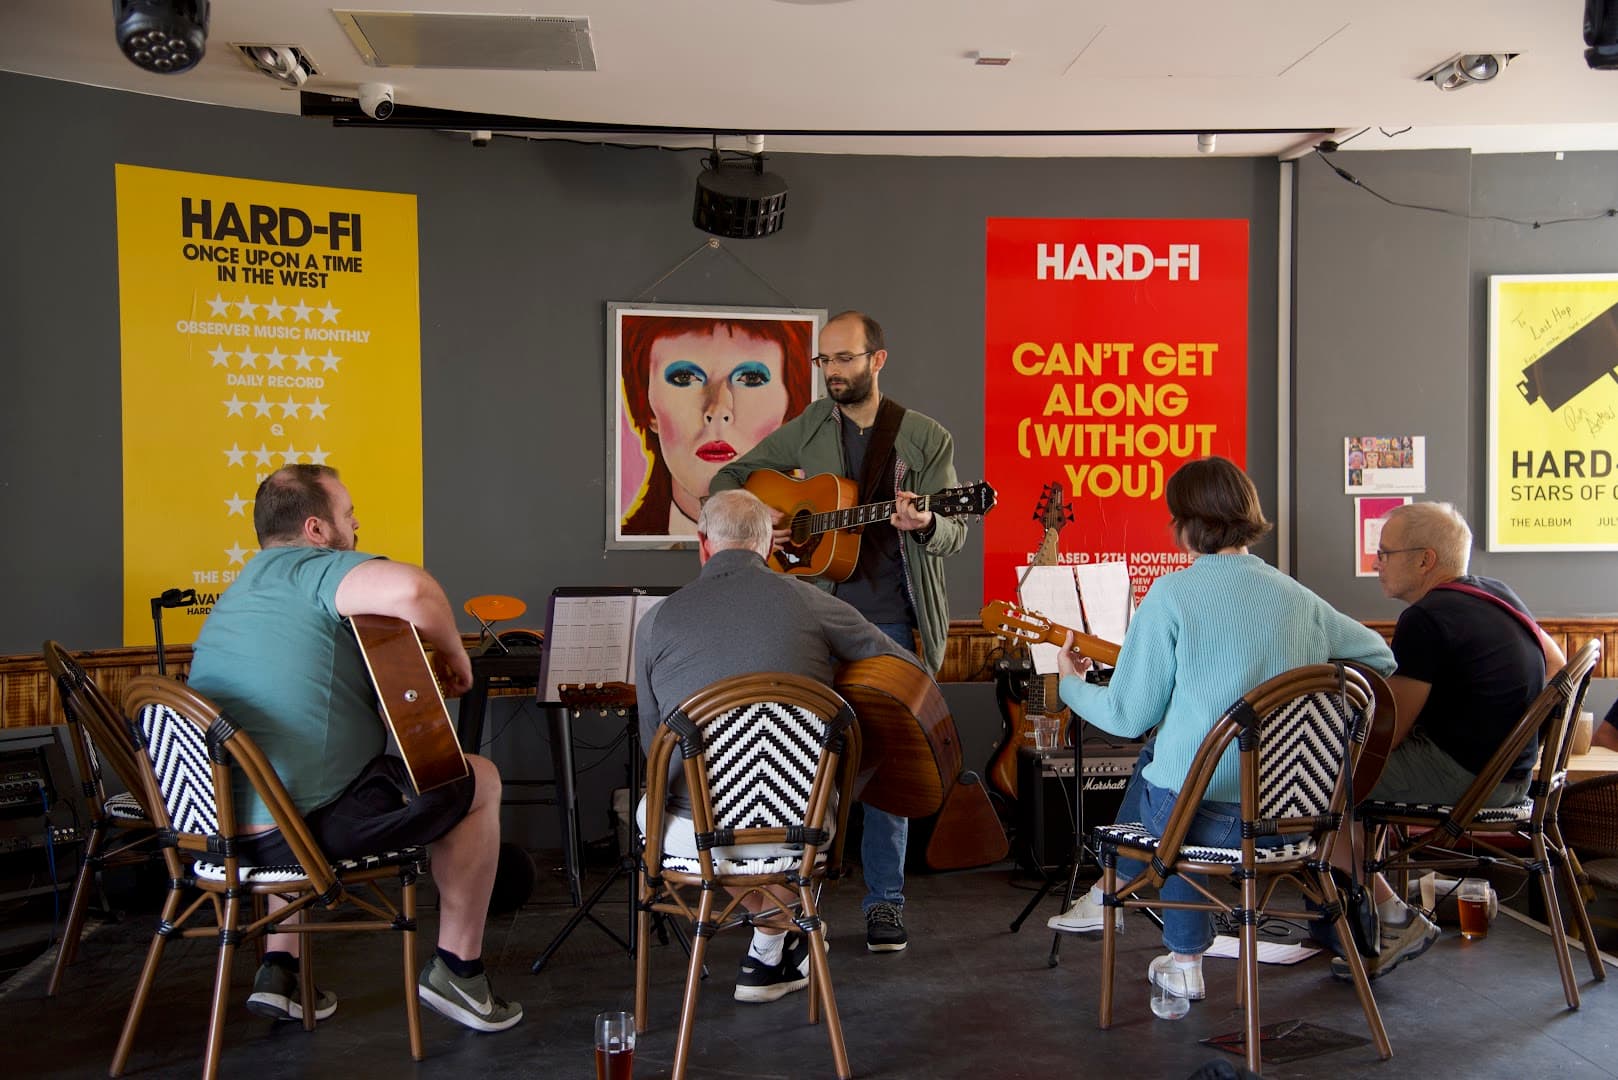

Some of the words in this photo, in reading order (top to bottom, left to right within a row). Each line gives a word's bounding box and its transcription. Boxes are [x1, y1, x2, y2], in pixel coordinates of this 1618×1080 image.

[181, 197, 362, 252] HARD-FI
[182, 243, 239, 264] ONCE
[246, 248, 300, 269] UPON
[305, 254, 319, 269] A
[322, 255, 363, 273] TIME
[1036, 243, 1200, 281] HARD-FI
[217, 265, 237, 282] IN
[241, 267, 274, 285] THE
[279, 270, 329, 289] WEST
[176, 319, 250, 337] OBSERVER
[254, 325, 300, 340] MUSIC
[304, 327, 371, 344] MONTHLY
[1012, 342, 1134, 377] CAN'T
[1142, 342, 1219, 377] GET
[227, 373, 264, 387] DAILY
[267, 374, 325, 389] RECORD
[1042, 383, 1189, 417] ALONG
[270, 423, 284, 437] Q
[1018, 417, 1217, 458] (WITHOUT
[1512, 450, 1618, 479] HARD
[1064, 459, 1164, 501] YOU)
[1511, 485, 1574, 501] STARS
[1580, 485, 1606, 501] OF
[1510, 518, 1531, 528] THE
[1533, 518, 1572, 528] ALBUM
[1026, 552, 1090, 564] RASED
[1094, 552, 1127, 564] 12TH
[1130, 552, 1195, 564] NOVEMBE
[192, 570, 219, 583] THE
[222, 570, 241, 583] SU
[187, 607, 212, 615] HARD
[1082, 777, 1127, 791] Marshall
